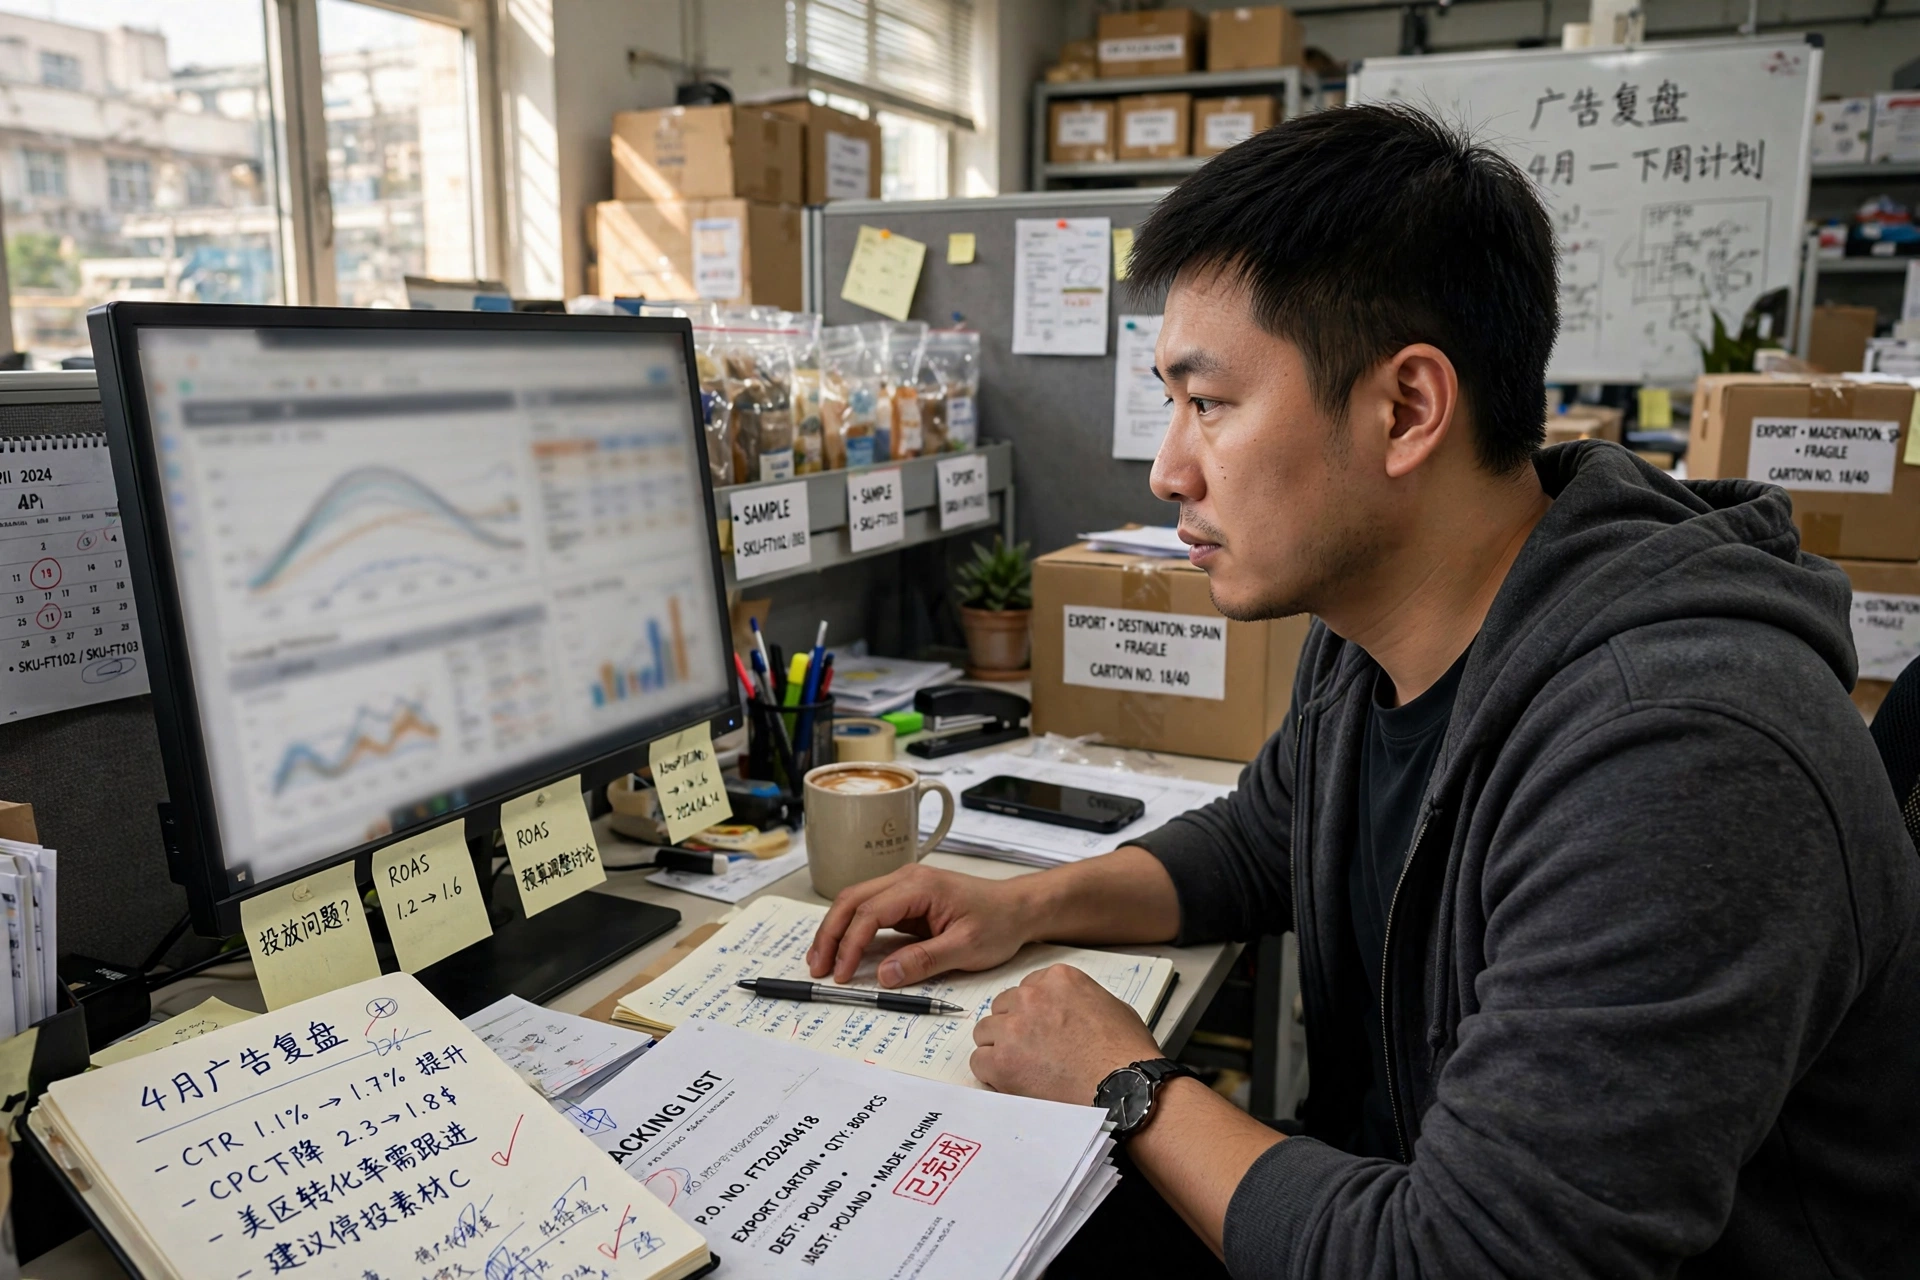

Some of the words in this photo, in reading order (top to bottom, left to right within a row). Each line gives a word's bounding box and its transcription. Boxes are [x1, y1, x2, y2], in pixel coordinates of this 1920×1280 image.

[1529, 79, 1688, 130] 广告复盘
[1633, 139, 1766, 182] 下周计划
[1756, 424, 1798, 438] EXPORT
[1804, 445, 1849, 459] FRAGILE
[20, 467, 53, 483] 2024
[1768, 467, 1813, 482] CARTON
[1815, 469, 1834, 482] NO.
[743, 499, 791, 526] SAMPLE
[860, 484, 892, 504] SAMPLE
[1068, 613, 1106, 631] EXPORT
[1190, 623, 1221, 641] SPAIN
[18, 652, 77, 673] SKU-FT102
[86, 641, 139, 661] SKU-FT103
[1124, 639, 1167, 657] FRAGILE
[1090, 662, 1133, 681] CARTON
[1135, 667, 1155, 683] NO.
[1160, 668, 1190, 687] 18/40
[516, 821, 549, 849] ROAS
[388, 854, 430, 888] ROAS
[397, 899, 418, 920] 1.2
[442, 876, 462, 900] 1.6
[141, 1021, 349, 1112] 4月广告复盘
[182, 1131, 244, 1166] CTR
[254, 1104, 309, 1138] 1.1%
[350, 1067, 405, 1101] 1.7%
[415, 1044, 467, 1076] 提升
[607, 1103, 685, 1165] ACKING
[676, 1070, 723, 1103] LIST
[209, 1138, 325, 1200] CPC下降
[337, 1120, 379, 1147] 2.3
[694, 1205, 726, 1226] P.O.
[719, 1183, 751, 1203] NO.
[743, 1115, 820, 1180] FT20240418
[731, 1198, 780, 1243] EXPORT
[774, 1159, 822, 1201] CARTON
[824, 1129, 855, 1152] QTY:
[846, 1111, 871, 1130] 800
[863, 1094, 888, 1113] PCS
[829, 1190, 873, 1232] POLAND
[873, 1151, 907, 1182] MADE
[899, 1138, 918, 1153] IN
[910, 1110, 943, 1139] CHINA
[237, 1121, 478, 1239] 美区转化率需跟进
[768, 1222, 806, 1255] DEST:
[797, 1179, 843, 1222] POLAND
